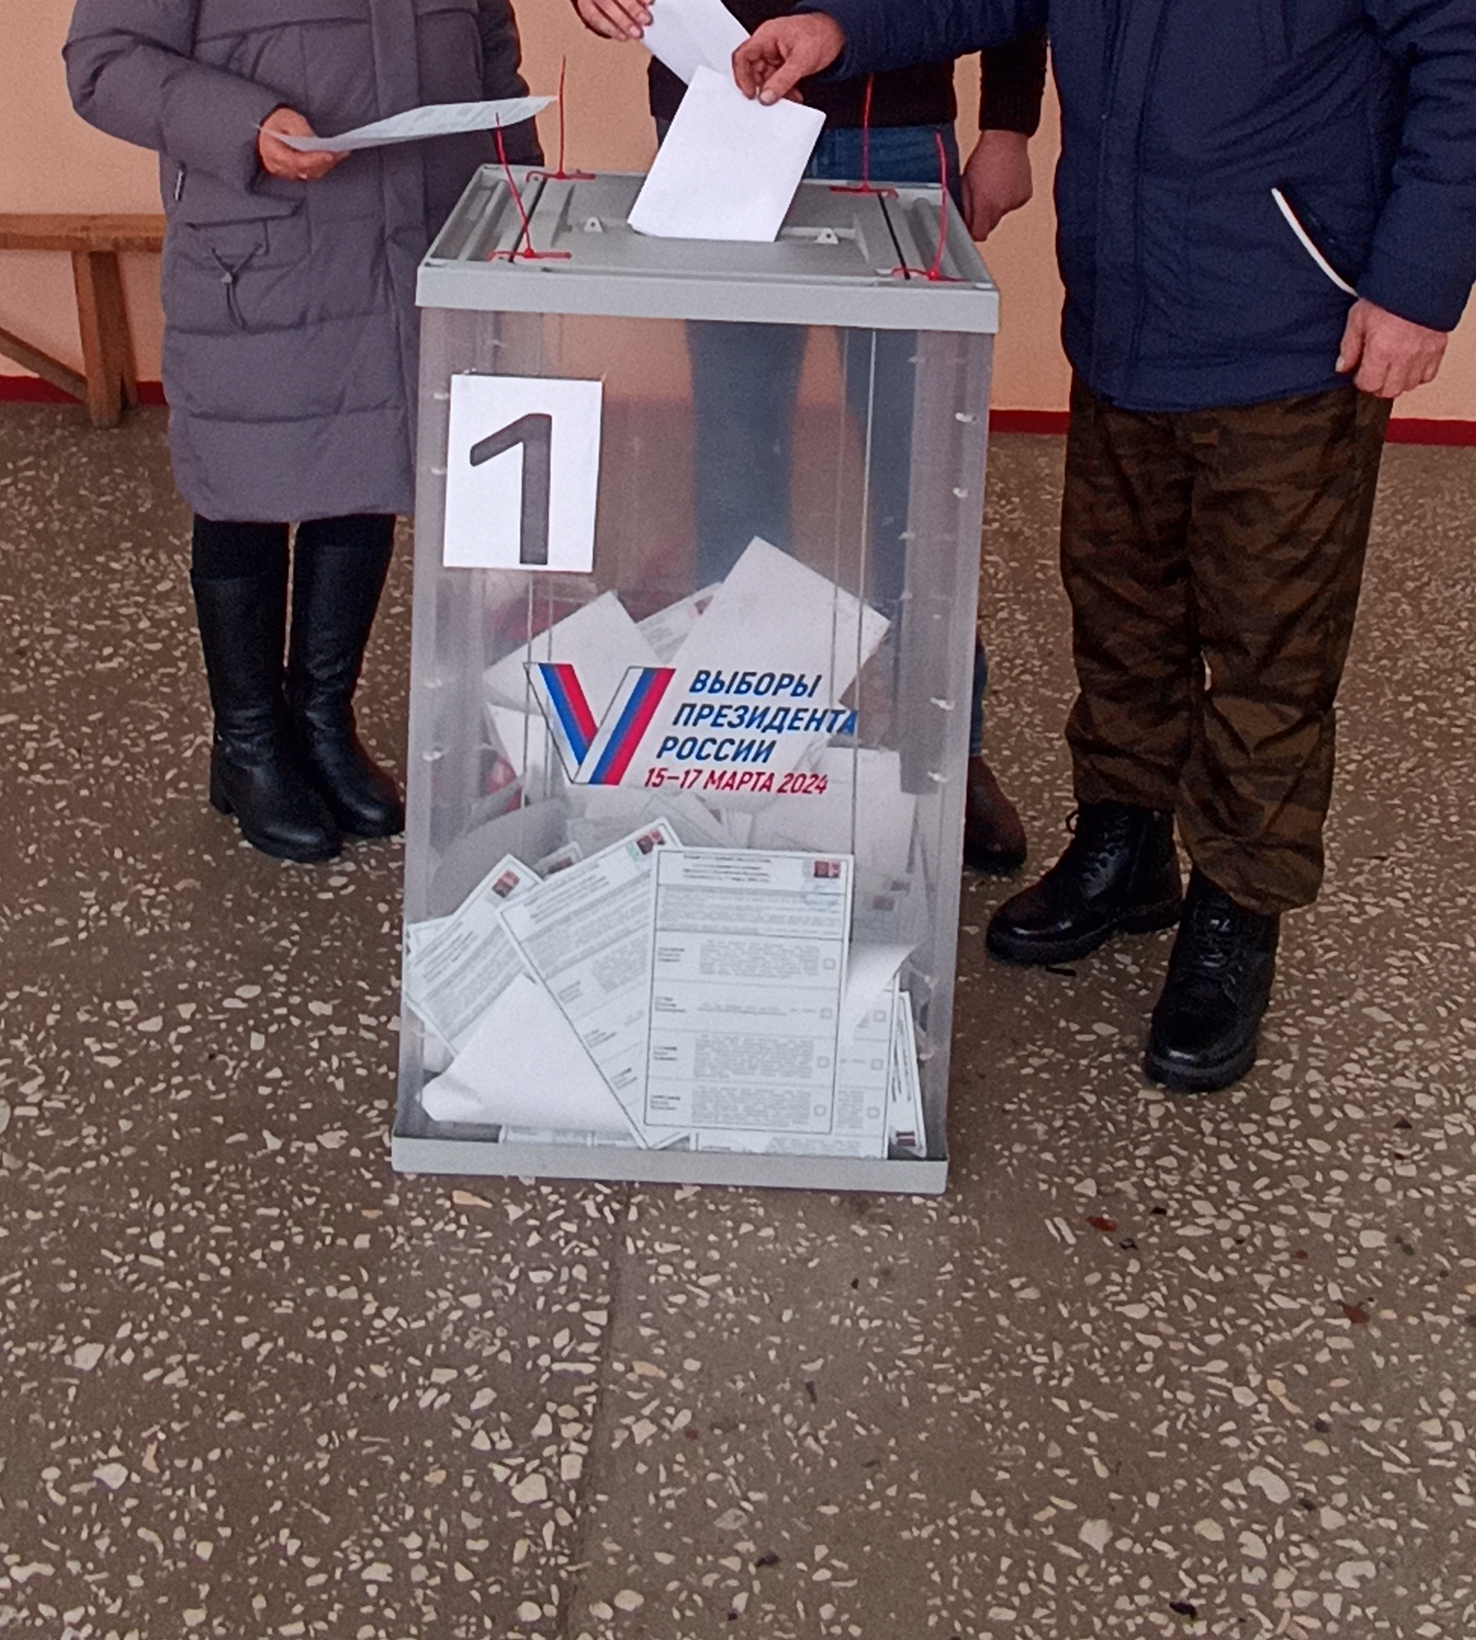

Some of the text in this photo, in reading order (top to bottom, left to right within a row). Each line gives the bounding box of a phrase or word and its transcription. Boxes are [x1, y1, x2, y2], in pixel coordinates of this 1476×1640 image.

[469, 413, 553, 566] 1
[689, 669, 823, 698] ВЫБОРЫ
[672, 703, 858, 736] ПРЕЗИДЕНТА
[656, 736, 777, 764] РОССИИ
[703, 770, 775, 793] МАРТА
[777, 773, 829, 795] 2024
